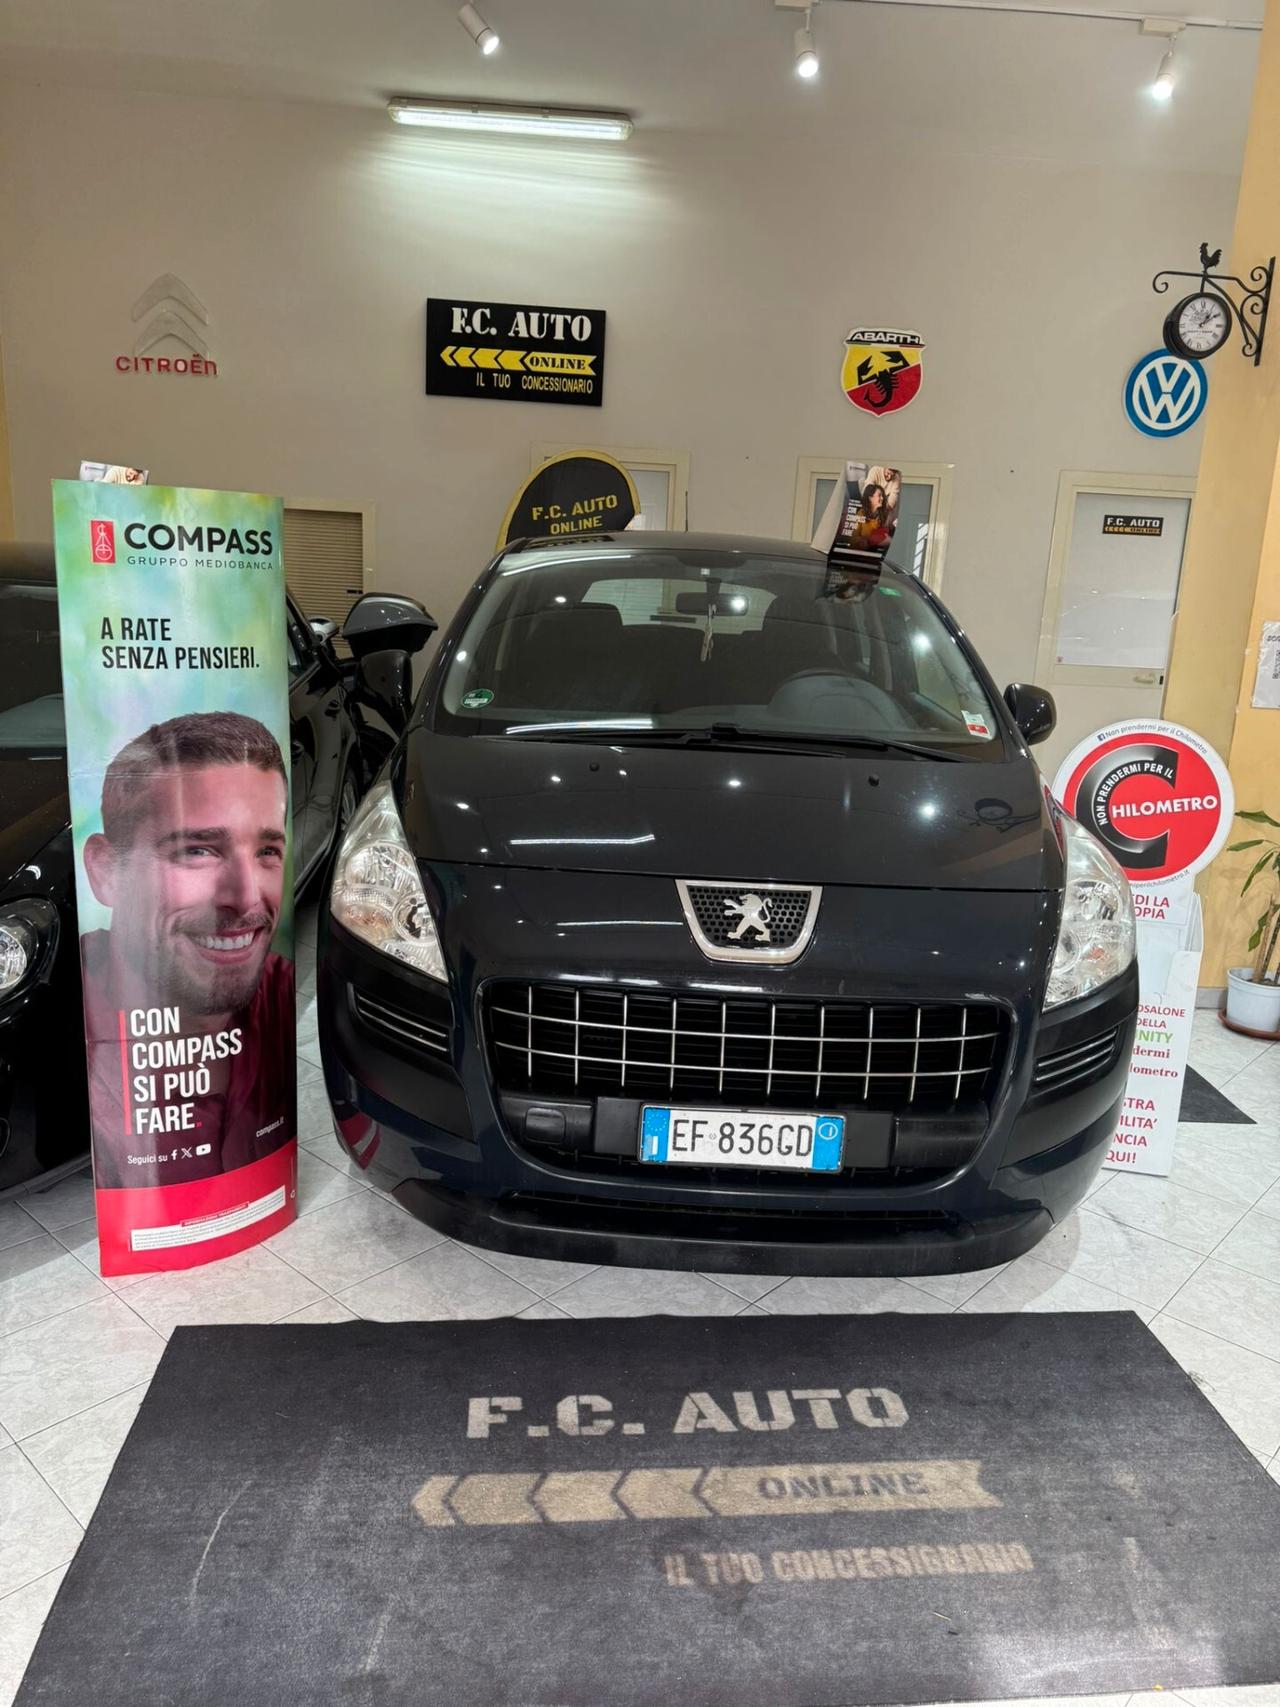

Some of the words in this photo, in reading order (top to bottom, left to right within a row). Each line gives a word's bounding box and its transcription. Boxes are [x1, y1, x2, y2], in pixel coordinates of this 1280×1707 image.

[451, 307, 497, 336] F.C.
[508, 311, 592, 342] AUTO
[852, 332, 919, 344] ABARTH
[529, 356, 586, 370] ONLINE
[476, 372, 485, 387] IL
[493, 373, 511, 389] TUO
[521, 375, 593, 394] CONCESSIONARIO
[532, 505, 567, 521] F.C.
[572, 494, 618, 516] AUTO
[550, 515, 603, 535] ONLINE
[1107, 517, 1126, 526] F.C.
[1130, 519, 1160, 527] AUTO
[124, 523, 273, 556] COMPASS
[128, 556, 188, 567] GRUPPO
[195, 559, 273, 570] MEDIOBANCA
[101, 617, 114, 640] A
[121, 617, 172, 641] RATE
[102, 646, 169, 670] SENZA
[175, 646, 260, 670] PENSIERI.
[1105, 729, 1120, 738] Non
[1121, 724, 1157, 733] prendermi
[1158, 725, 1169, 733] per
[1176, 729, 1208, 754] Chilometro
[1144, 762, 1162, 774] PER
[1164, 768, 1175, 779] IL
[1097, 763, 1141, 802] PRENDERMI
[1096, 804, 1108, 825] NON
[1131, 894, 1149, 906] DI
[1154, 896, 1170, 908] LA
[1135, 906, 1165, 919] OPIA
[1137, 1004, 1186, 1017] OSALONE
[130, 1006, 180, 1037] CON
[1135, 1030, 1173, 1043] NITY
[132, 1028, 242, 1070] COMPASS
[1132, 1045, 1170, 1059] dermi
[1130, 1063, 1178, 1078] lometro
[134, 1075, 156, 1103] SI
[164, 1063, 210, 1100] PUÒ
[1123, 1097, 1155, 1111] TRA
[256, 1116, 285, 1138] compass.it
[1120, 1115, 1158, 1129] ILITA'
[672, 1119, 708, 1152] EF
[718, 1122, 813, 1157] 836GD
[1113, 1133, 1147, 1147] NCIA
[127, 1154, 156, 1166] Seguici
[158, 1154, 168, 1163] su
[466, 1394, 646, 1440] F.C.
[673, 1387, 910, 1434] AUTO
[757, 1472, 929, 1500] ONLINE
[664, 1552, 694, 1587] IL
[702, 1551, 764, 1585] TUO
